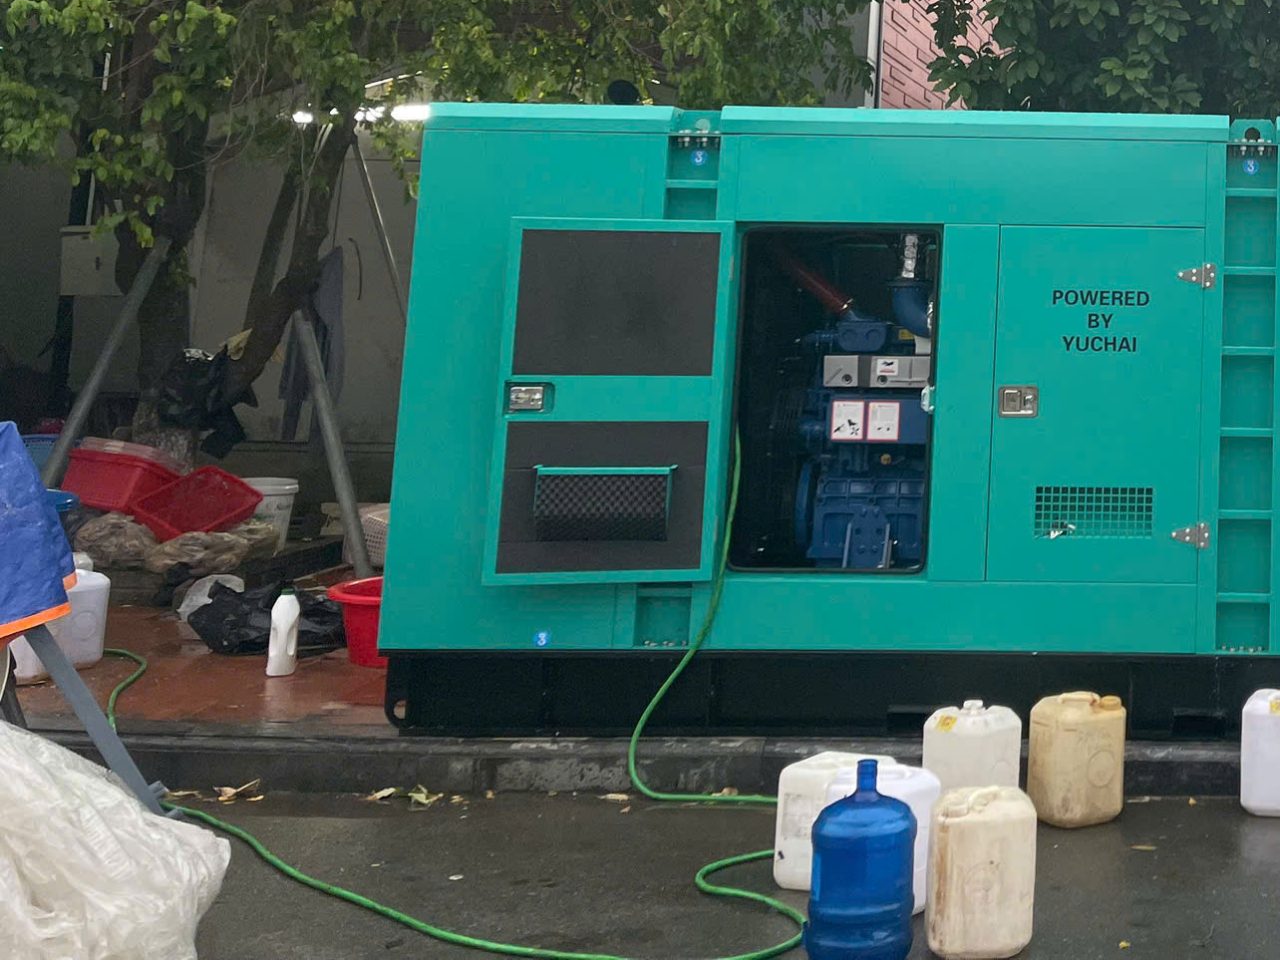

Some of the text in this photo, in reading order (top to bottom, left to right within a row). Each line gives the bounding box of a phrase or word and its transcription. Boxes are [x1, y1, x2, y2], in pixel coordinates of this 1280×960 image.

[1052, 290, 1150, 306] POWERED
[1088, 313, 1113, 328] BY
[1062, 336, 1136, 352] YUCHAI
